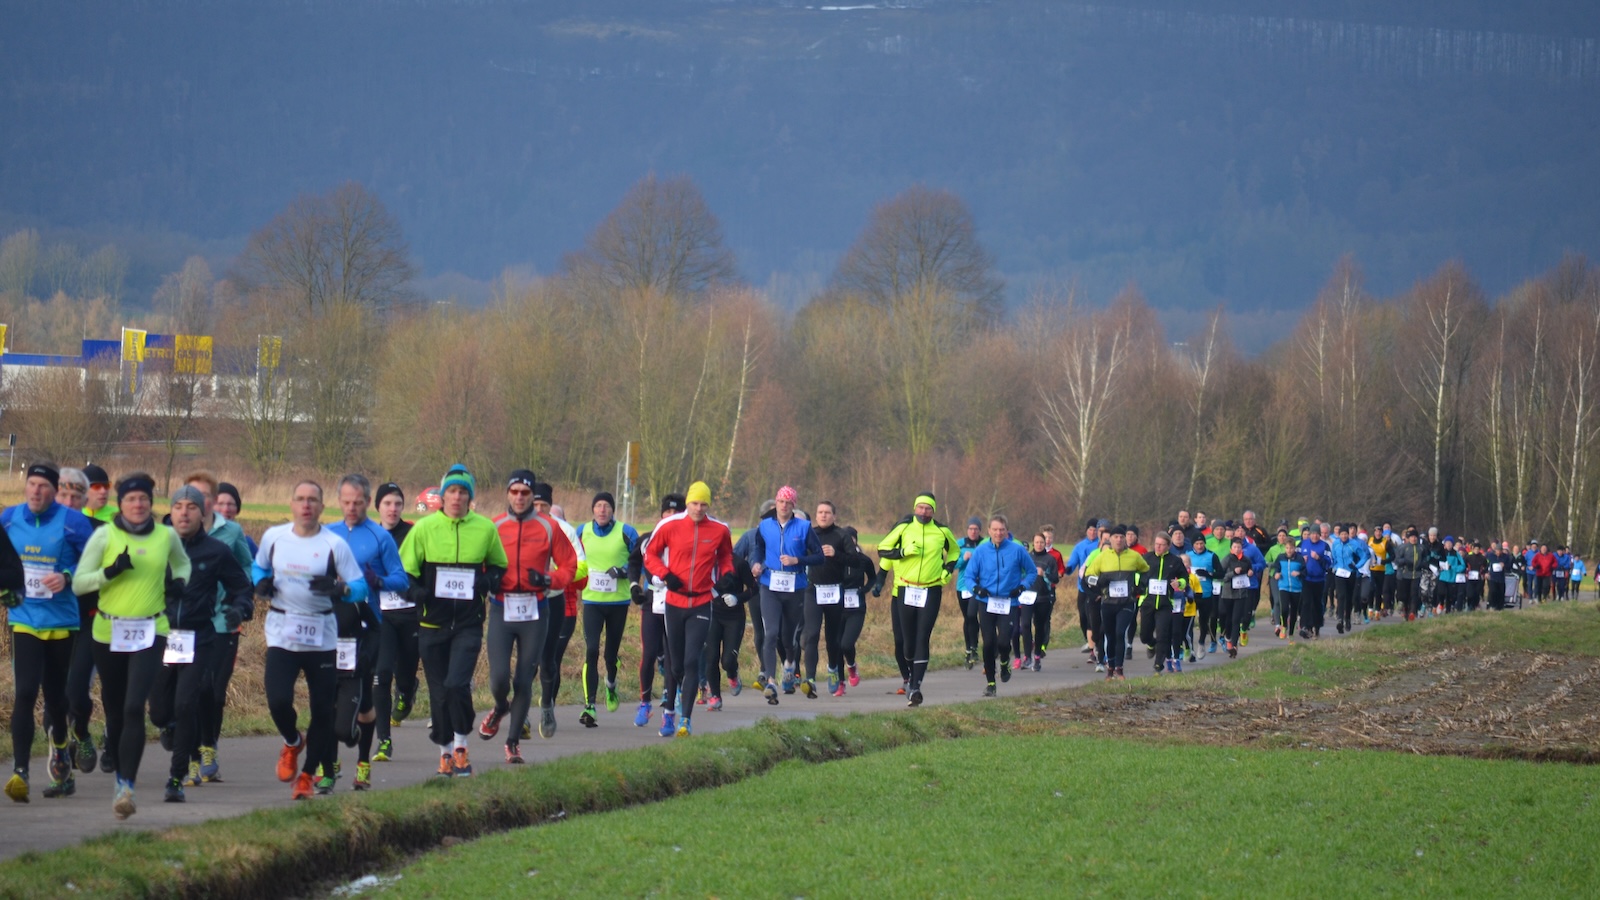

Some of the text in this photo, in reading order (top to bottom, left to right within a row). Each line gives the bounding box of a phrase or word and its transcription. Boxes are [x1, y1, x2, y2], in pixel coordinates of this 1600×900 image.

[145, 348, 173, 359] ETRO
[25, 545, 41, 553] PSV
[444, 580, 465, 590] 496
[388, 592, 399, 601] 38
[516, 605, 527, 614] 13
[123, 629, 146, 640] 273
[295, 624, 316, 636] 310
